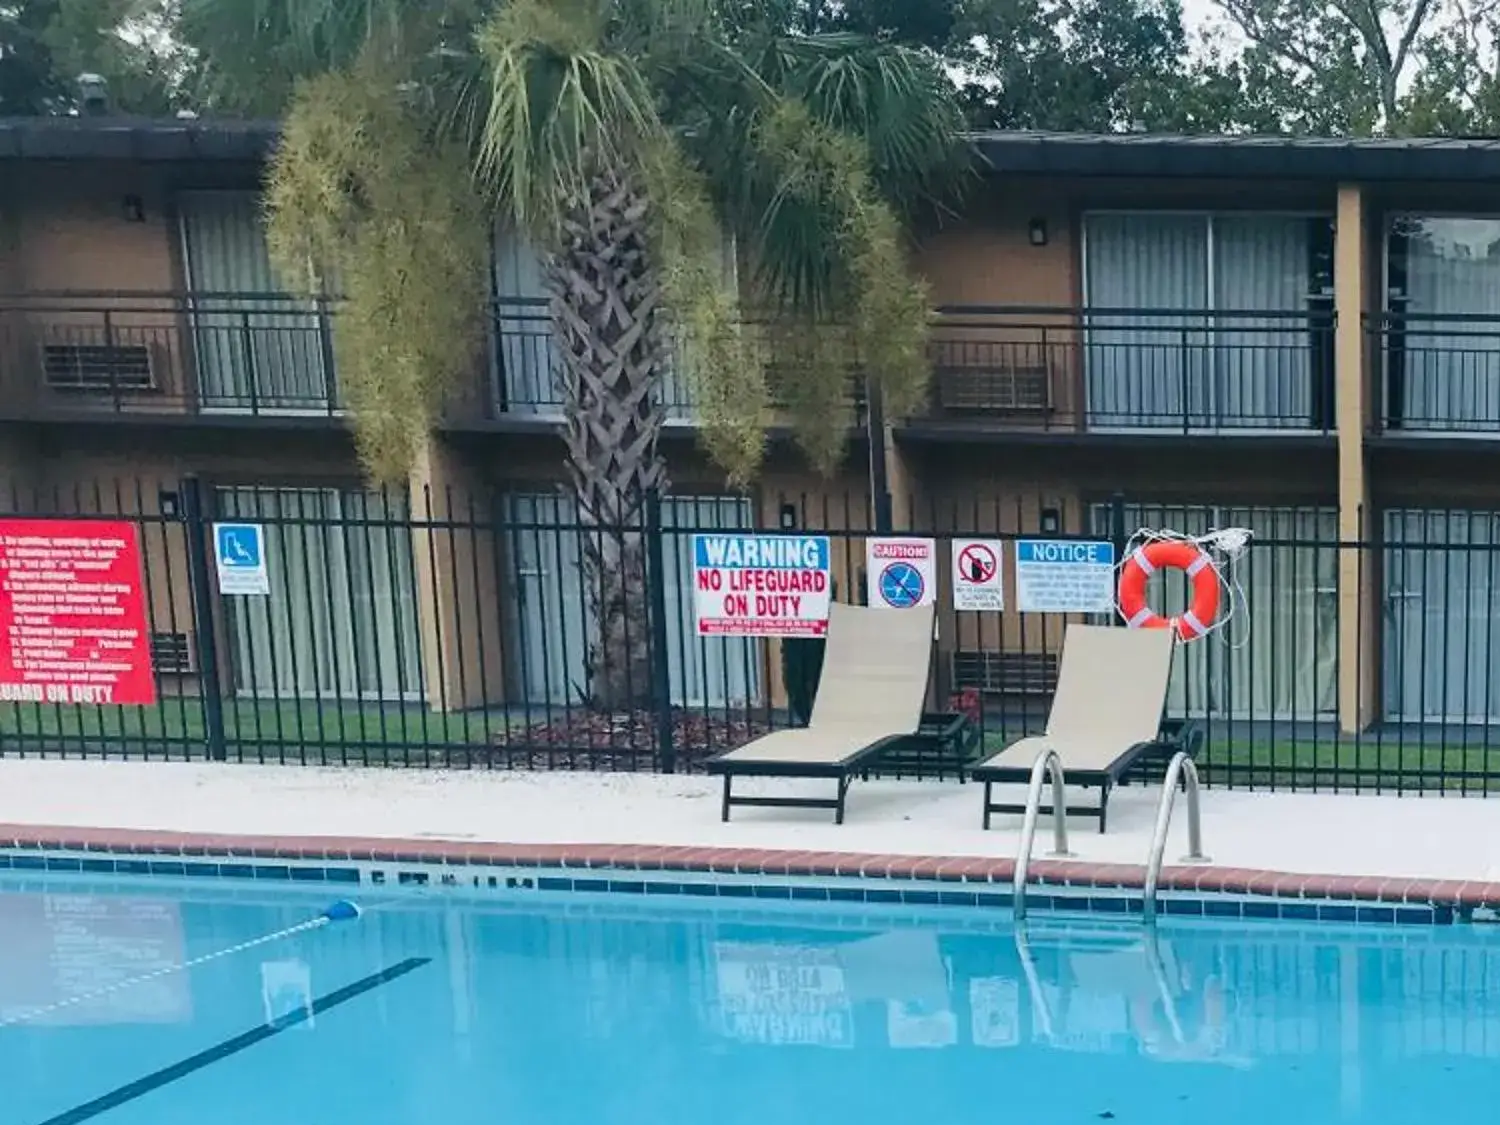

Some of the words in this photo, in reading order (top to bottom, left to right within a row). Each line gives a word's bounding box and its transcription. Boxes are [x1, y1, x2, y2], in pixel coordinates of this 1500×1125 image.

[705, 538, 819, 568] WARNING
[1032, 543, 1098, 562] NOTICE
[697, 569, 722, 592] NO
[729, 569, 826, 593] LIFEGUARD
[724, 594, 749, 617] ON
[755, 595, 801, 618] DUTY
[71, 684, 112, 703] DUTY
